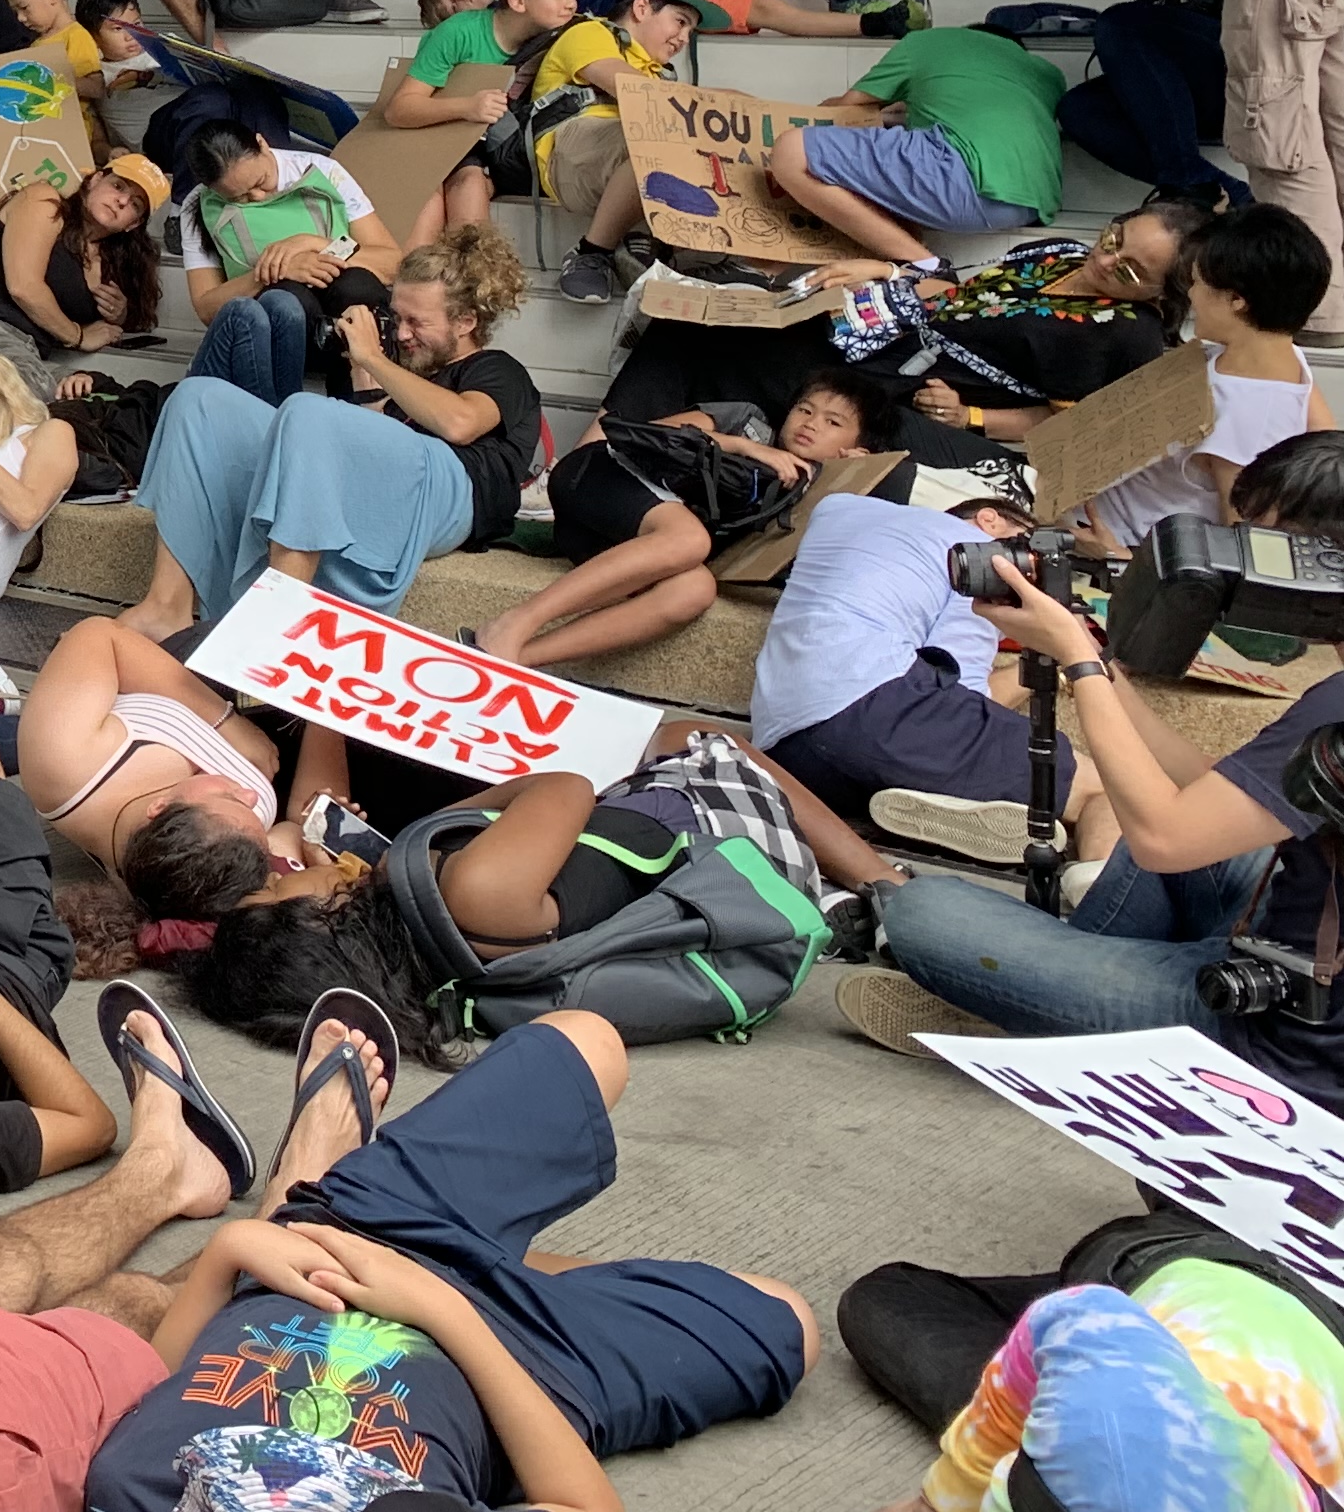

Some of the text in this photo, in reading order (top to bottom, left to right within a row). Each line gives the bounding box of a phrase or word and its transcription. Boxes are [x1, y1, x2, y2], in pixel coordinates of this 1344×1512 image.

[668, 96, 751, 144] YOU
[243, 665, 531, 775] CLIMATE
[282, 650, 560, 760] ACTION
[283, 608, 575, 736] NOW
[237, 1336, 410, 1422] YOUR
